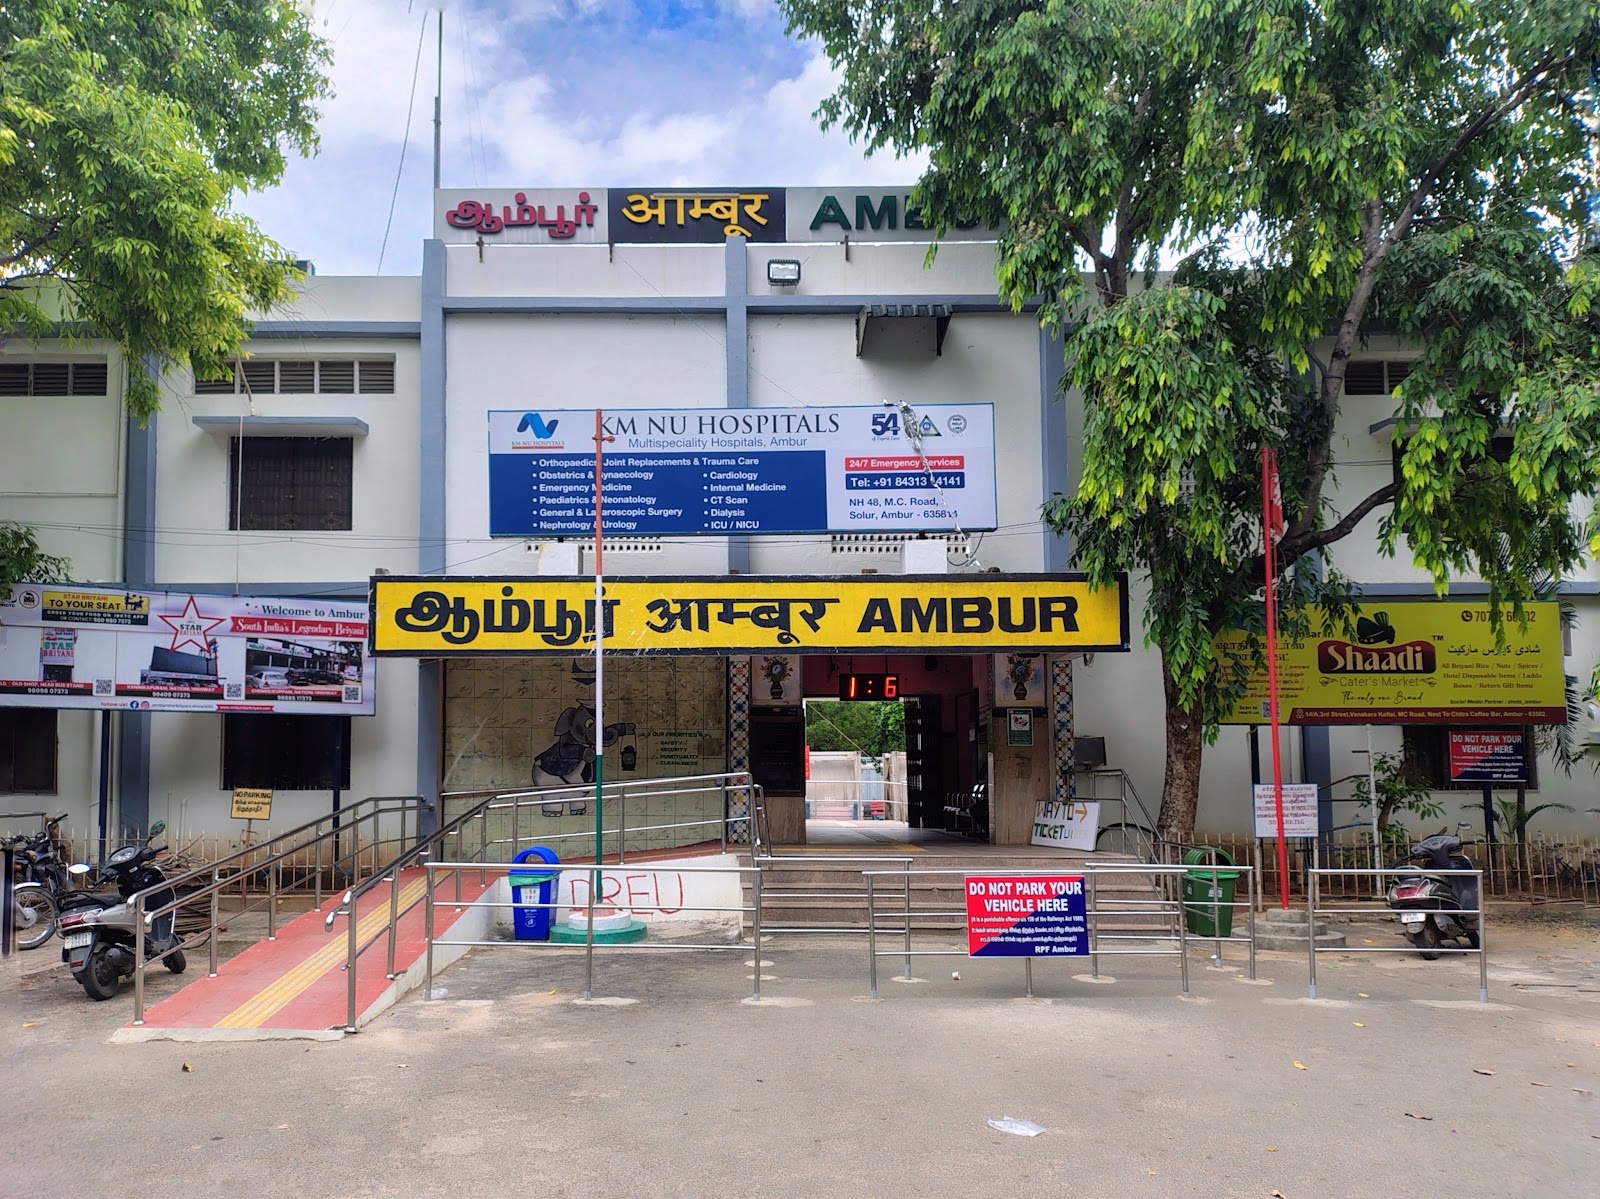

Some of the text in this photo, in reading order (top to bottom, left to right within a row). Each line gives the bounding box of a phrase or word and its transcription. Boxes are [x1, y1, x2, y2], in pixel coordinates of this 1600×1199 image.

[446, 192, 598, 238] ஆம்பூர்
[621, 193, 769, 237] आम्बूर
[648, 416, 687, 435] NU
[697, 413, 840, 434] HOSPITALS
[628, 436, 807, 450] Multispeciality Hospitals, Ambur
[603, 457, 760, 467] Joint Replacements & Trauma Care
[849, 459, 868, 468] 24/7
[870, 459, 920, 469] Emergency
[539, 472, 585, 480] Obstetrics
[710, 471, 758, 480] Cardiology
[851, 476, 927, 487] Tel: +91 84313
[540, 484, 589, 493] Emergency
[746, 483, 787, 491] Medicine
[540, 496, 656, 505] Paediatrics Neonatology
[710, 496, 748, 504] CT Scan
[849, 497, 939, 507] NH 48, M.C. Road,
[540, 509, 574, 517] General
[585, 508, 646, 517] Laaroscopic
[647, 508, 683, 517] Surgery
[710, 509, 745, 518] Dialysis
[849, 511, 913, 520] Solur, Ambur
[540, 520, 637, 531] Nephrology Urology
[711, 520, 760, 529] ICU NICU
[66, 600, 94, 609] YOUR
[97, 602, 121, 610] SEAT
[262, 605, 365, 619] Welcome to Ambur
[856, 596, 1081, 633] AMBUR
[645, 597, 840, 645] आम्बूर
[237, 619, 364, 636] South India's Legendary Briyani
[44, 642, 73, 650] STAR
[1328, 645, 1423, 671] Shaadi
[1340, 677, 1419, 687] Cater's Market
[1341, 691, 1355, 704] The
[1357, 692, 1376, 705] only
[1394, 691, 1423, 704] Brand
[1465, 735, 1479, 743] NOT
[1481, 735, 1500, 743] PARK
[1502, 735, 1522, 743] YOUR
[1462, 745, 1514, 753] VEHICLE HERE
[1036, 801, 1074, 820] WAY TO
[1034, 823, 1065, 840] TICKET
[969, 882, 1082, 895] DO NOT PARK YOUR
[984, 899, 1068, 912] VEHICLE HERE
[1052, 945, 1077, 953] Ambur
